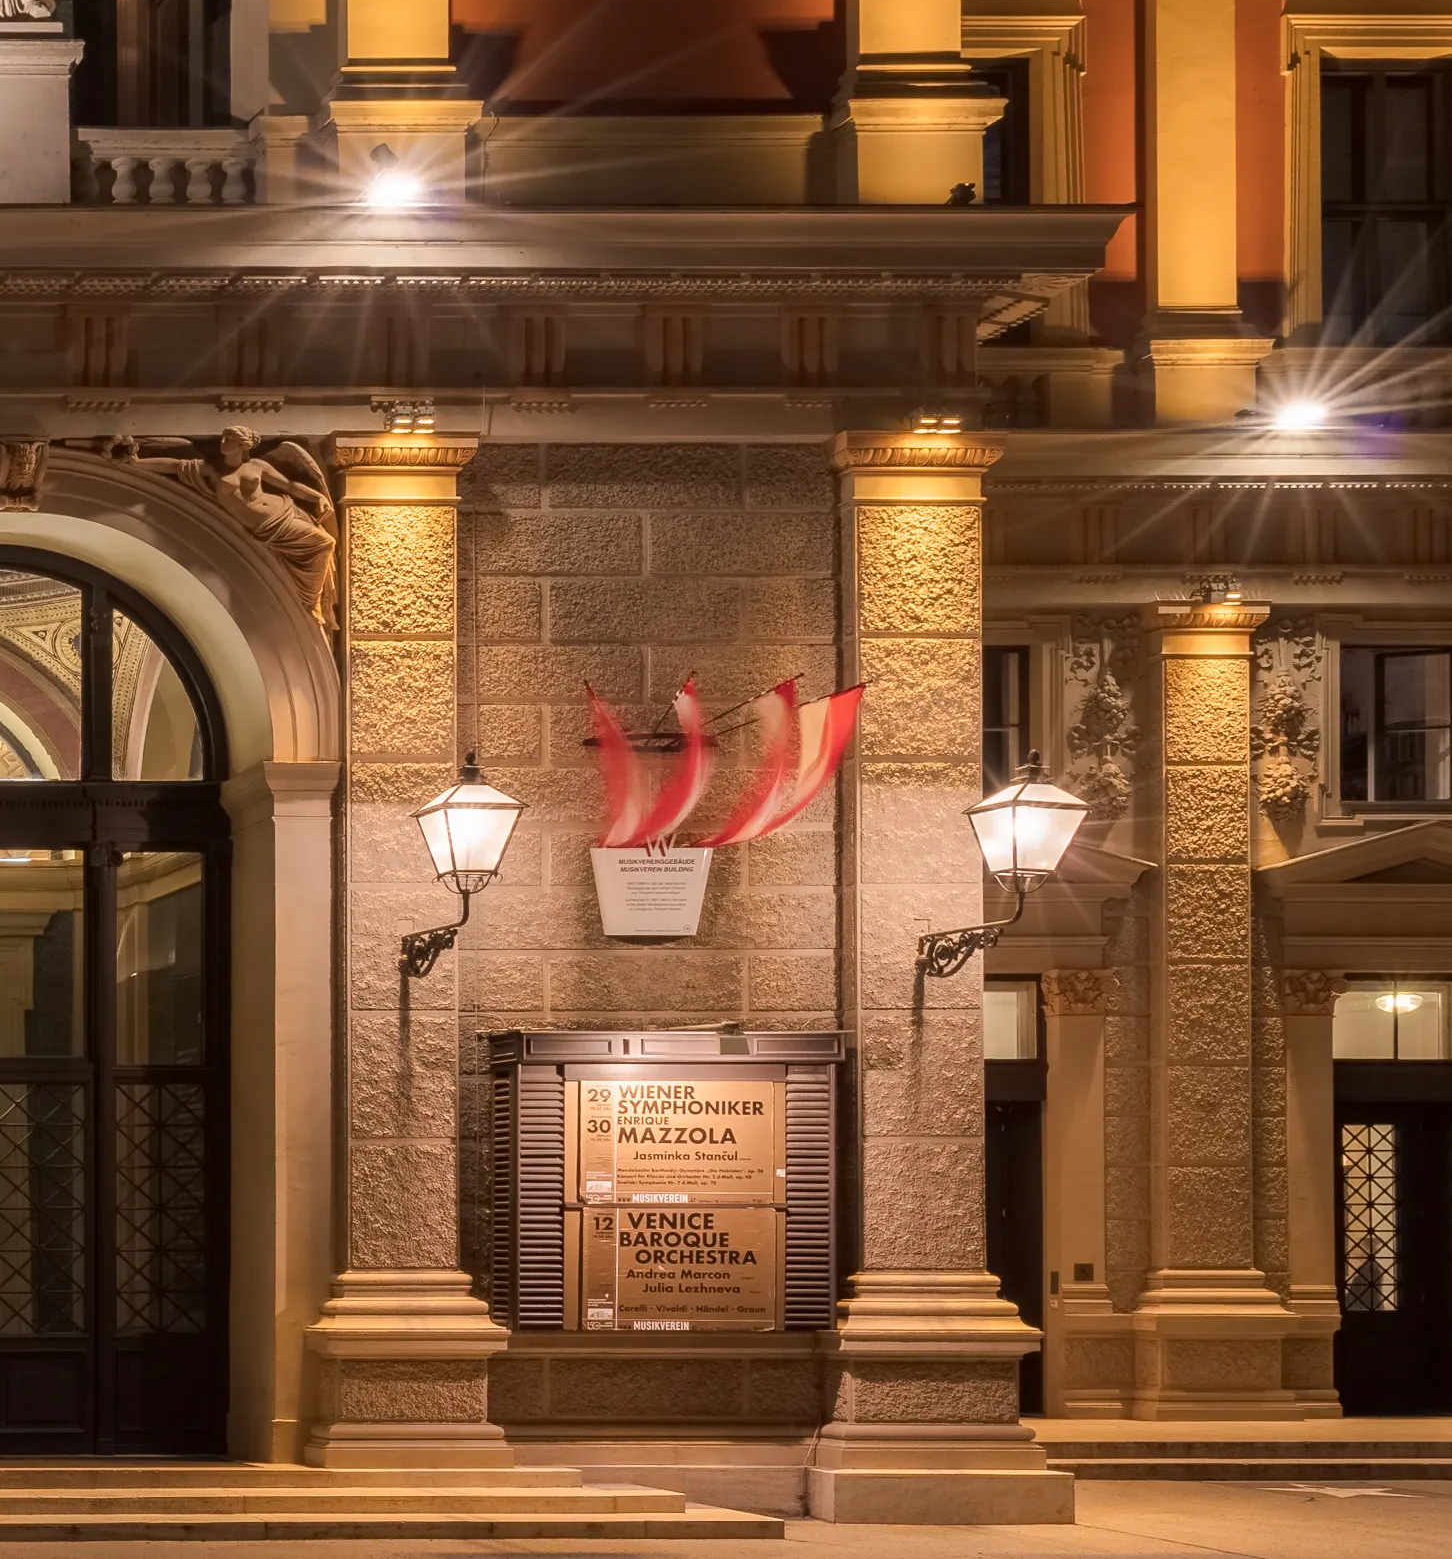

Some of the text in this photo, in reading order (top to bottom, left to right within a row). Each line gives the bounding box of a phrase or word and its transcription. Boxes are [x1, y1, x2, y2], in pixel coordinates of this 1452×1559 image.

[588, 1089, 611, 1102] 29
[619, 1085, 695, 1100] WIENER
[618, 1100, 764, 1115] SYMPHONIKER
[587, 1119, 611, 1133] 30
[617, 1116, 669, 1126] ENRIQUE
[618, 1127, 737, 1144] MAZZOLA
[633, 1151, 738, 1161] Jasminka Stančul
[632, 1194, 688, 1203] MUSIKVEREIN
[593, 1217, 614, 1230] 12
[627, 1212, 714, 1230] VENICE
[619, 1232, 729, 1248] BAROQUE
[635, 1249, 757, 1265] ORCHESTRA
[626, 1269, 730, 1280] Andrea Marcon
[643, 1283, 741, 1294] Julia Lezhneva
[618, 1304, 766, 1313] Corelli Vivaldi Händel Graun
[633, 1321, 689, 1330] MUSIKVEREIN
